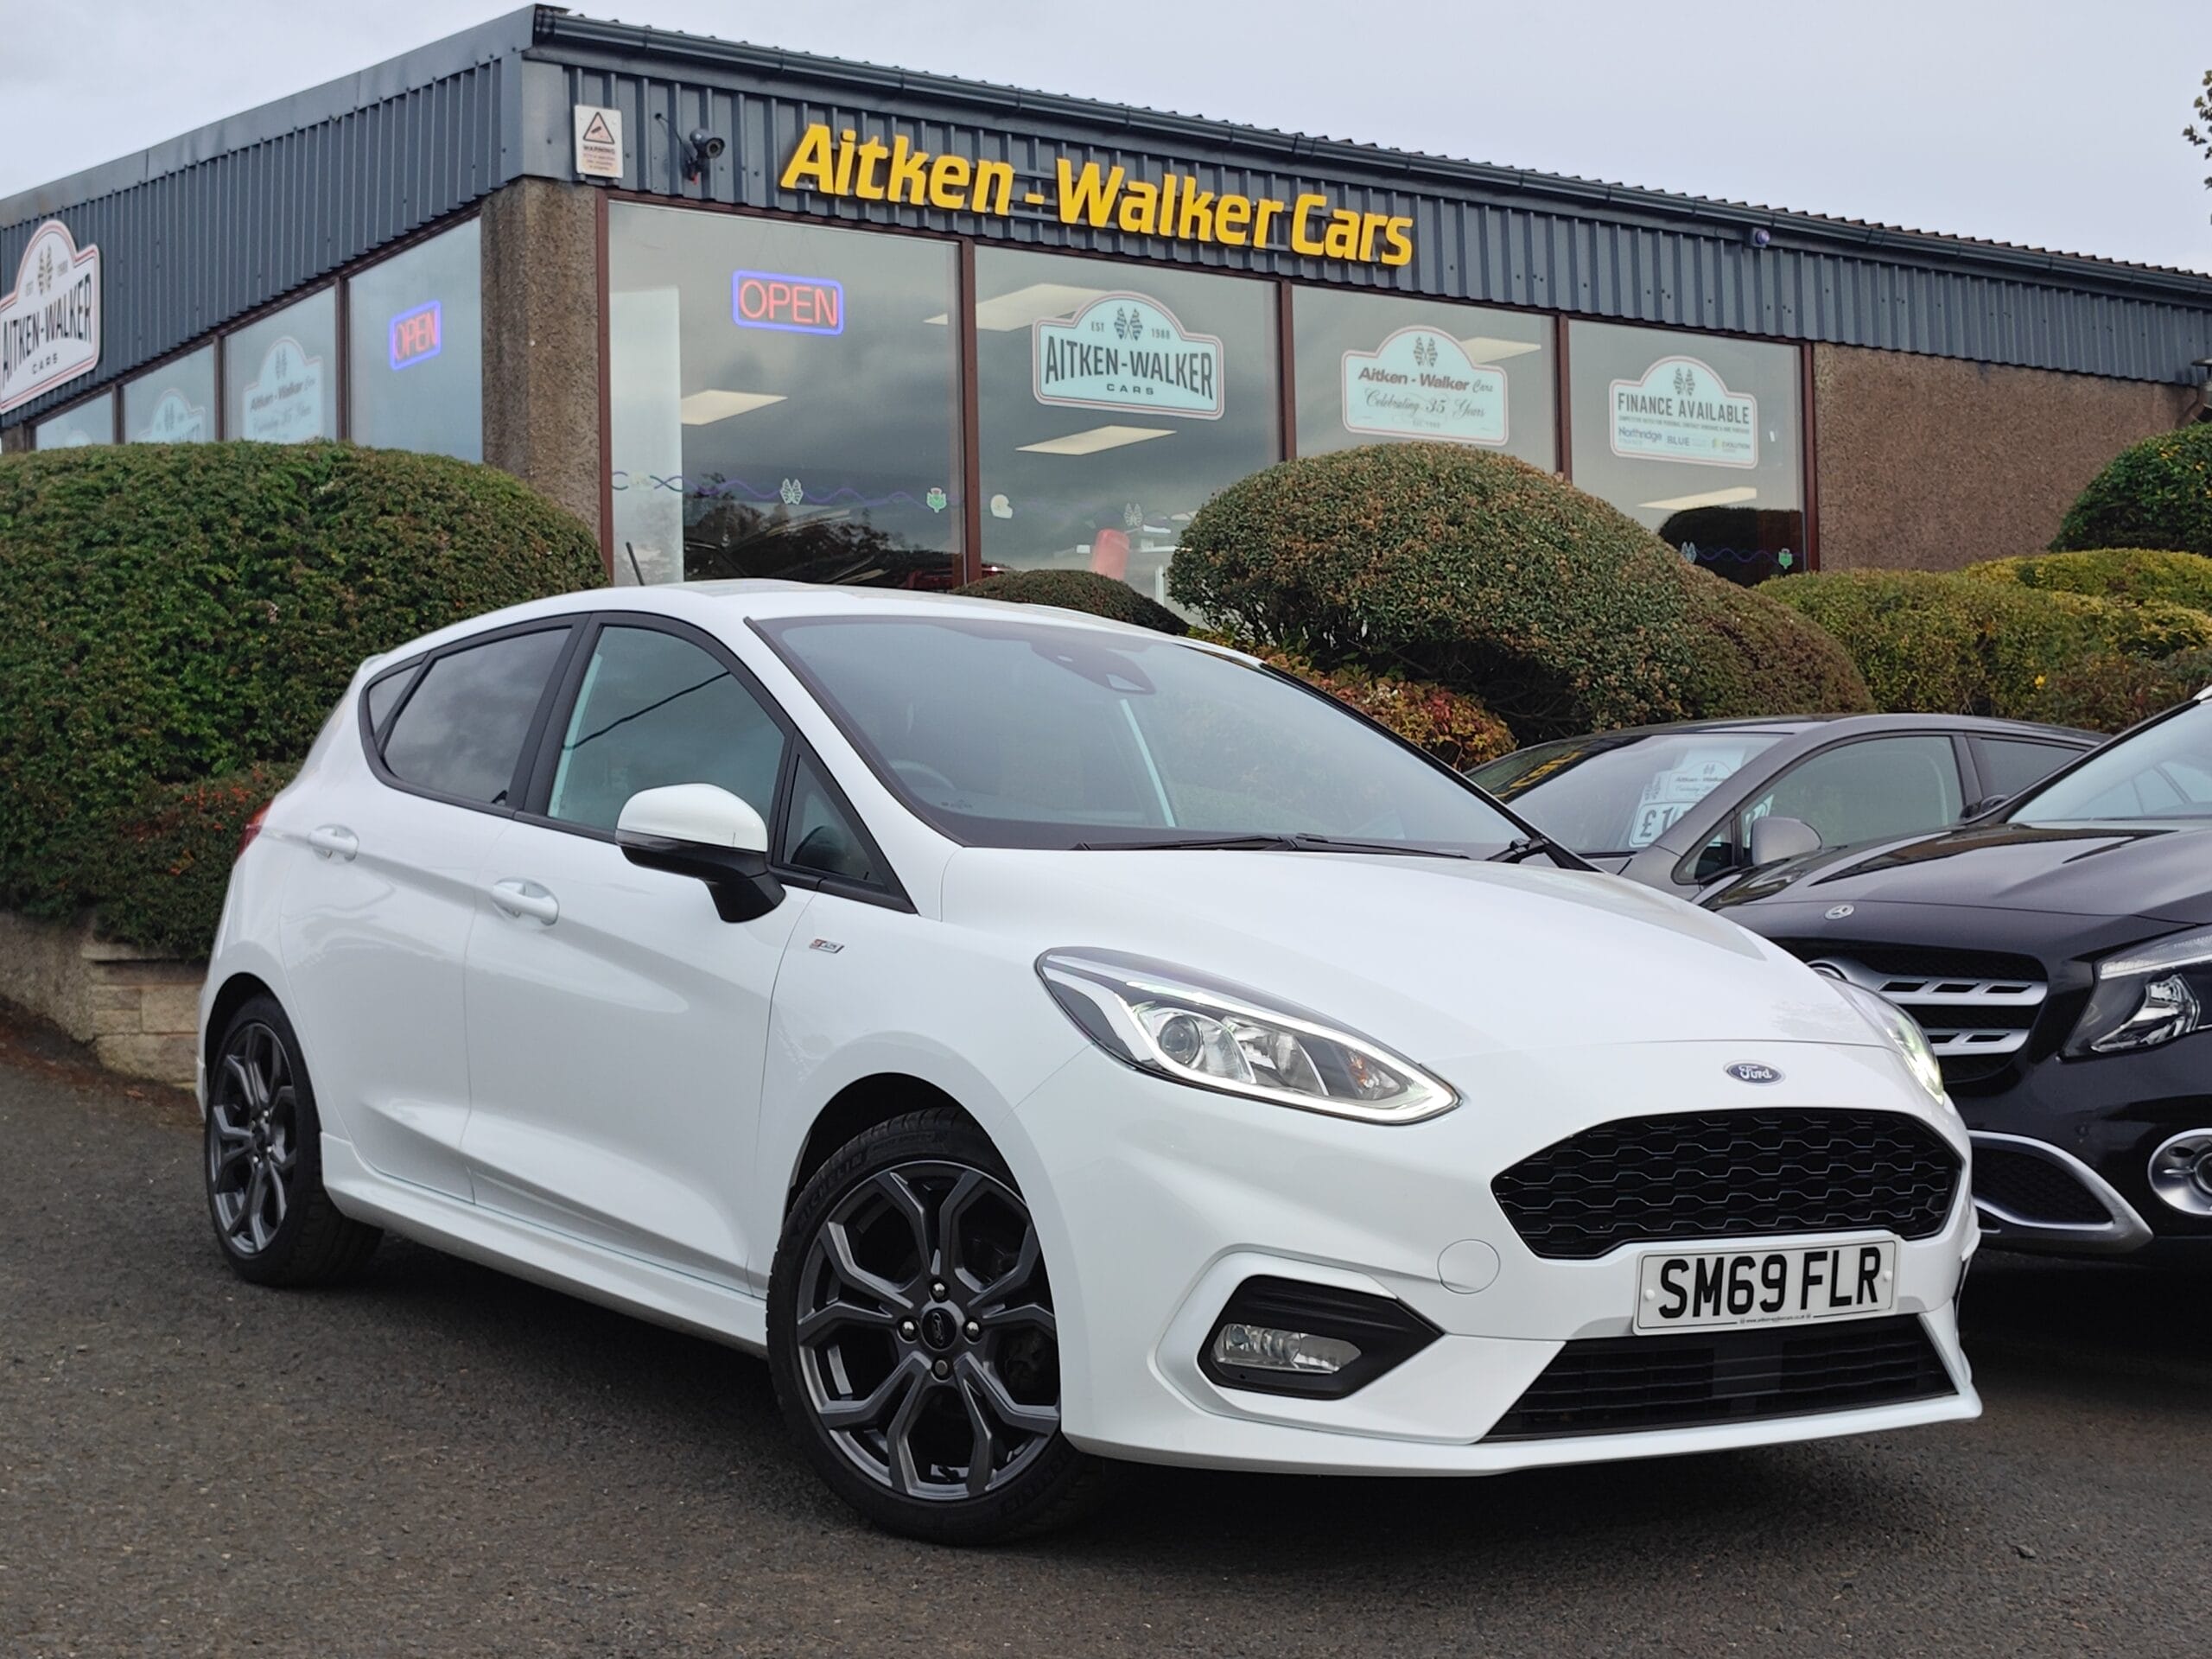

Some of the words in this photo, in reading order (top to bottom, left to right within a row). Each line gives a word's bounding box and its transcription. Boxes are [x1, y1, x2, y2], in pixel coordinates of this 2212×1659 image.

[781, 123, 1014, 216] Aitken
[1025, 193, 1045, 206] -
[1057, 157, 1284, 250] Walker
[1291, 192, 1414, 267] Cars
[740, 278, 838, 327] OPEN
[2, 272, 92, 391] AITKEN-WALKER
[395, 309, 438, 360] OPEN
[1090, 321, 1104, 333] EST
[32, 353, 58, 374] CARS
[1046, 335, 1213, 401] AITKEN-WALKER
[1358, 366, 1408, 385] Aitken
[1420, 372, 1471, 391] Walker
[1106, 383, 1154, 396] CARS
[1364, 387, 1421, 416] Celebrating
[1426, 398, 1446, 414] 35
[1452, 397, 1485, 420] Years
[1618, 392, 1674, 416] FINANCE
[1678, 399, 1750, 425] AVAILABLE
[1666, 435, 1691, 447] BLUE
[1738, 1065, 1772, 1079] Ford
[1658, 1253, 1787, 1319] SM69
[1800, 1246, 1881, 1310] FLR
